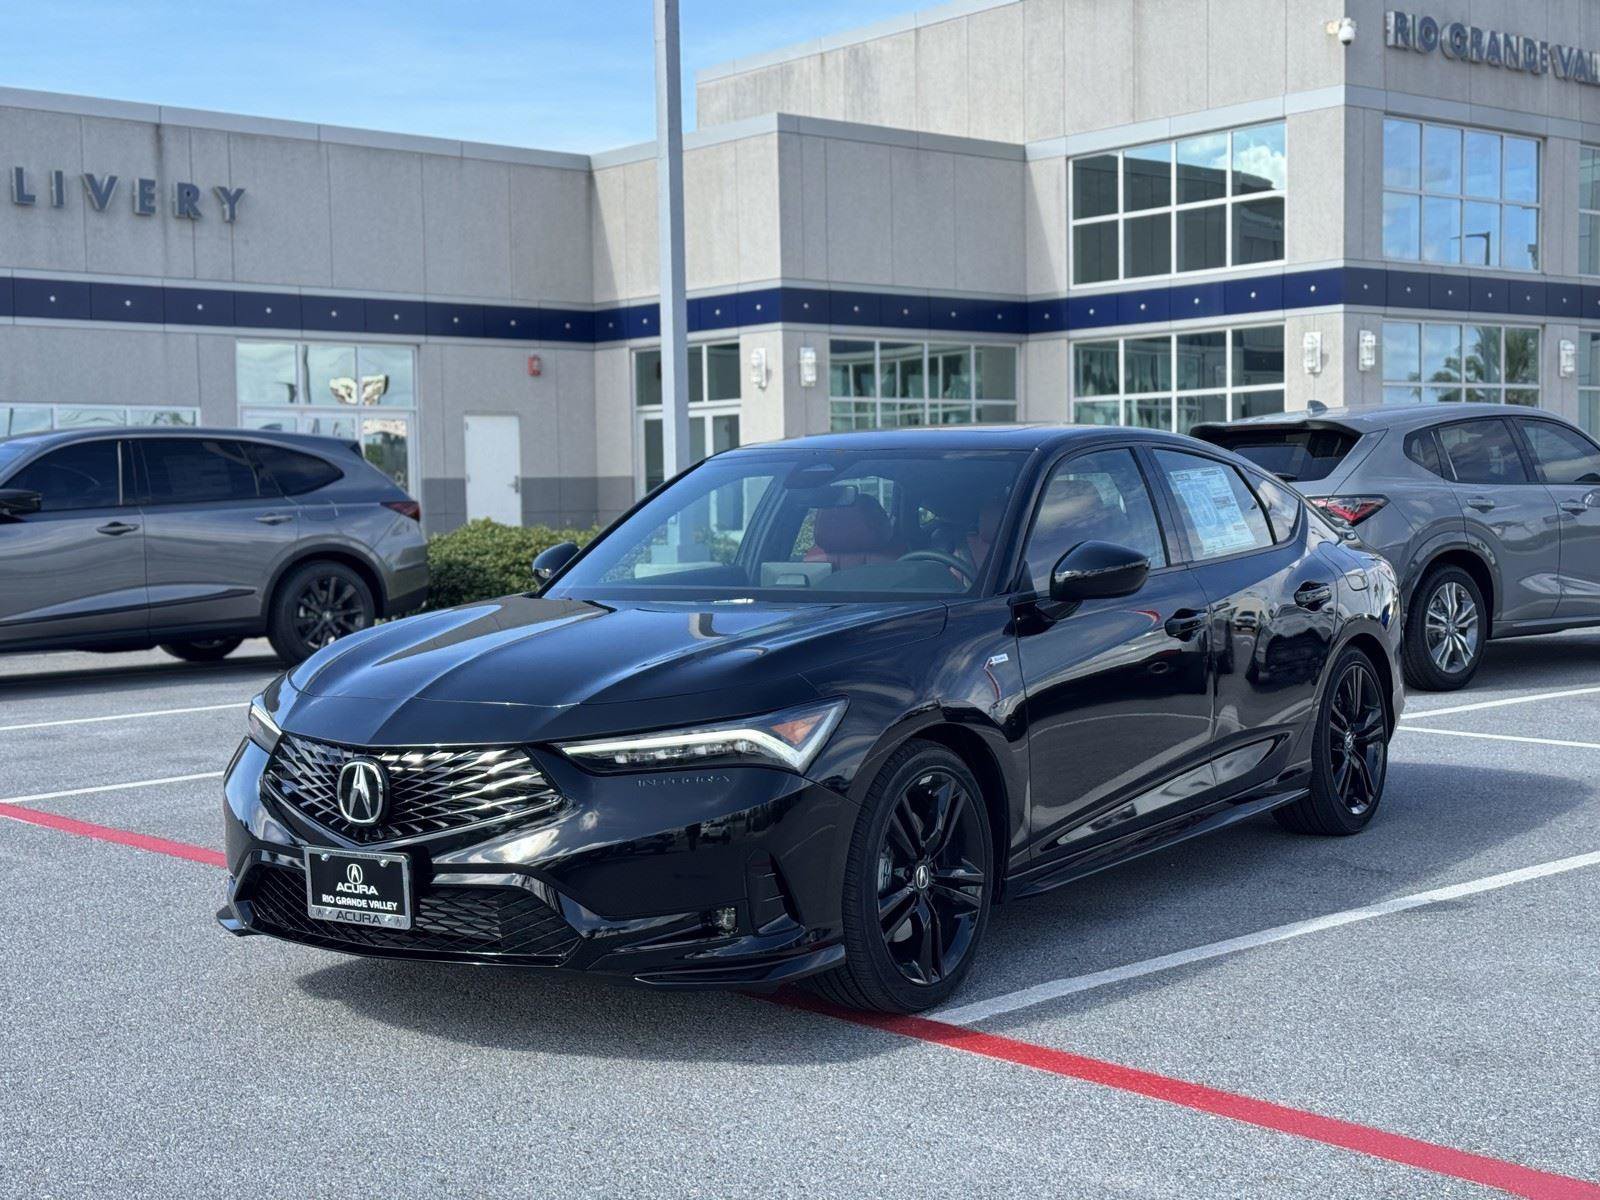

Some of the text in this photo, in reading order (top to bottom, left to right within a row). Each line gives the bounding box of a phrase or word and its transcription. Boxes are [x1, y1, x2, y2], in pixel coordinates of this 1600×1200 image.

[1385, 11, 1600, 86] RIO GRANDE VAL
[11, 166, 245, 223] LIVERY
[336, 882, 378, 895] ACURA
[322, 894, 397, 911] RIO GRANDE VALLEY
[336, 911, 381, 924] ACURA
